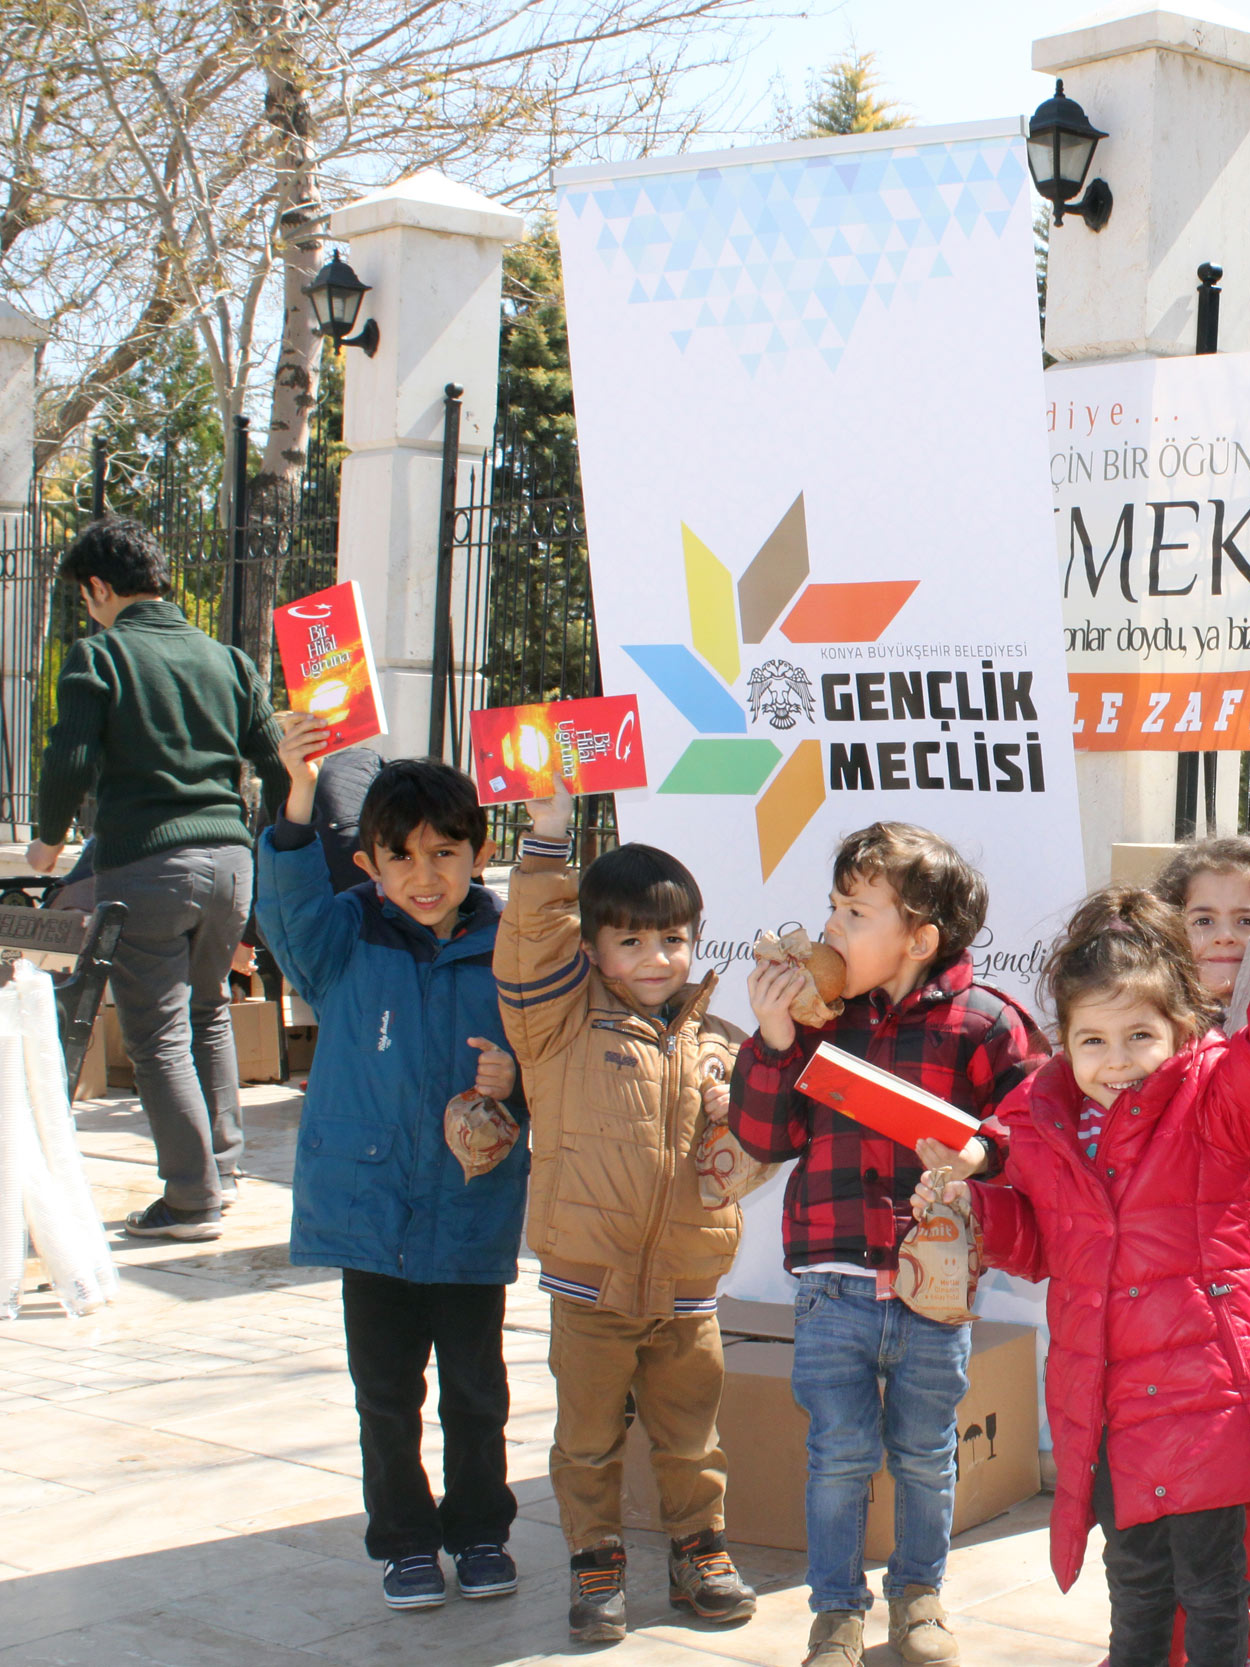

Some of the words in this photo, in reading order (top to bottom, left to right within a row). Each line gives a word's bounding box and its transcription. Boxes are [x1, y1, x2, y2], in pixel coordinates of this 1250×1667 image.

[1050, 446, 1094, 493] ÇİN
[1103, 441, 1150, 482] BİR
[308, 623, 330, 642] Bir
[820, 647, 863, 660] KONYA
[867, 643, 951, 661] BÜYÜKŞEHİR
[955, 641, 1029, 658] BELEDİYESİ
[1117, 618, 1187, 661] doydu,
[1192, 625, 1220, 661] ya
[300, 651, 351, 679] Uğruna
[820, 659, 1038, 732] GENÇLİK
[554, 720, 576, 778] Uğruna
[593, 733, 611, 757] Bir
[829, 731, 1046, 793] MECLİSİ
